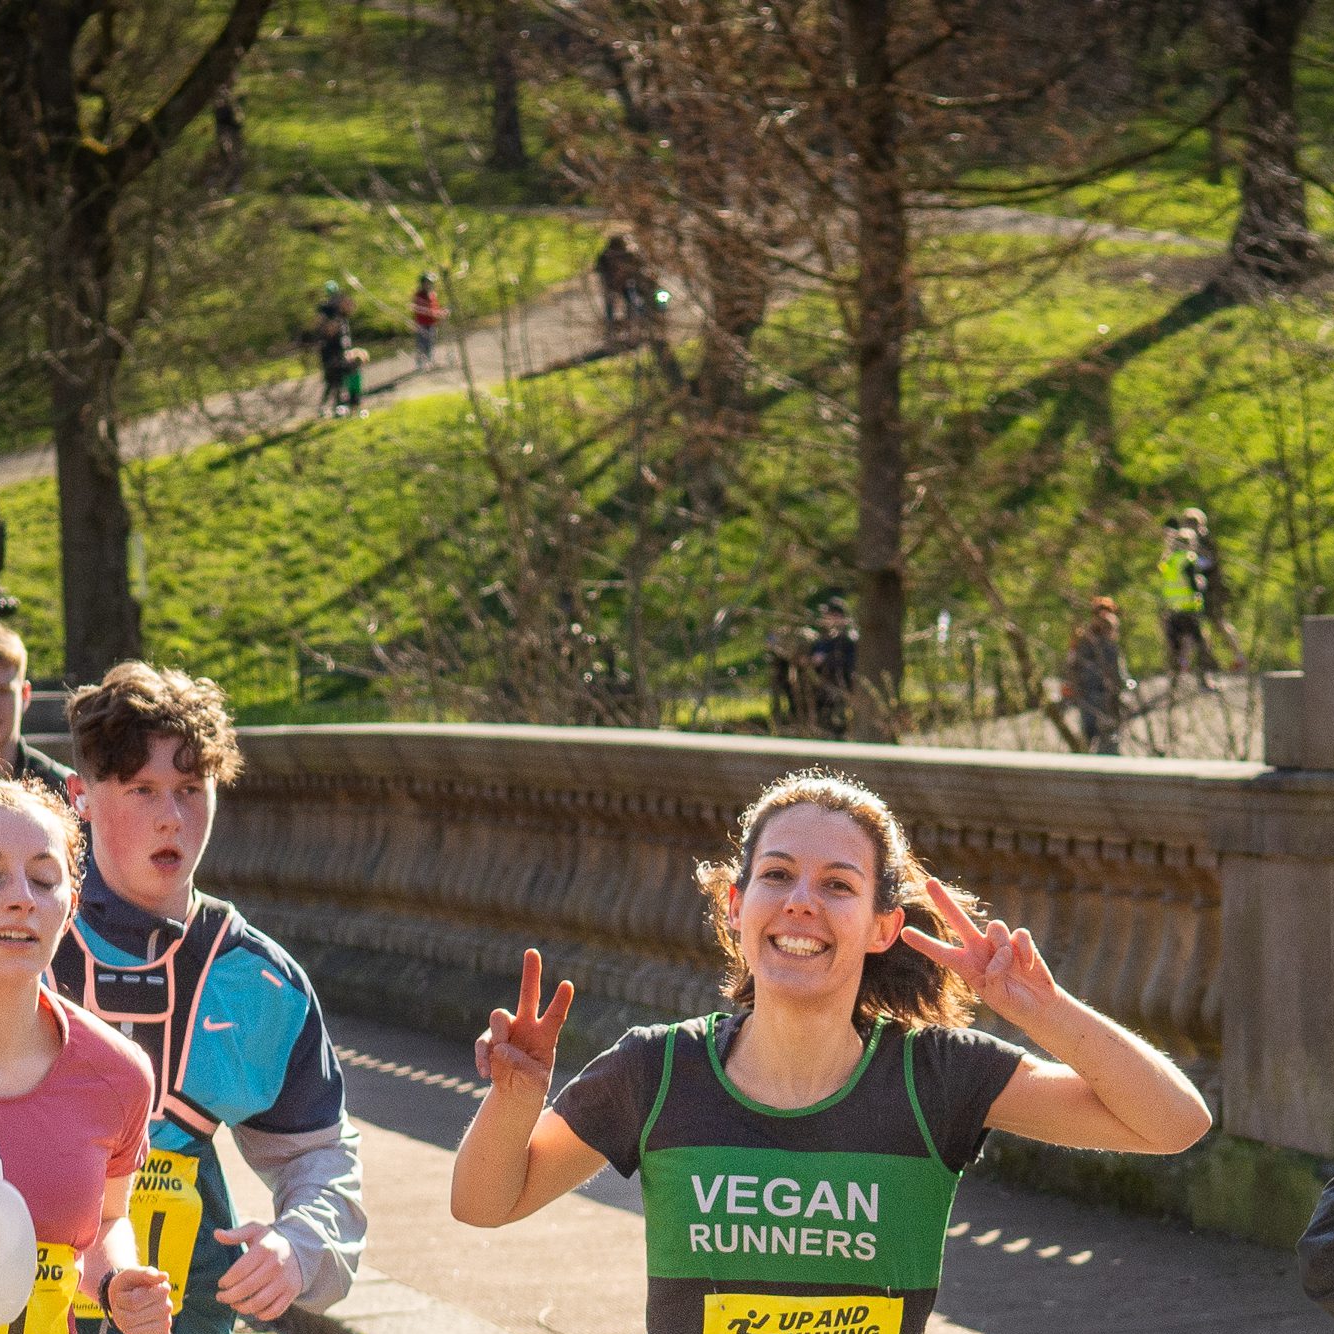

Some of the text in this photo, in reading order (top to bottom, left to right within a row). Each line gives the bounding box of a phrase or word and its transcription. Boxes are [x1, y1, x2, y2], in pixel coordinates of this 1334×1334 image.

[691, 1174, 879, 1222] VEGAN
[689, 1224, 877, 1261] RUNNERS
[779, 1305, 870, 1331] UP AND
